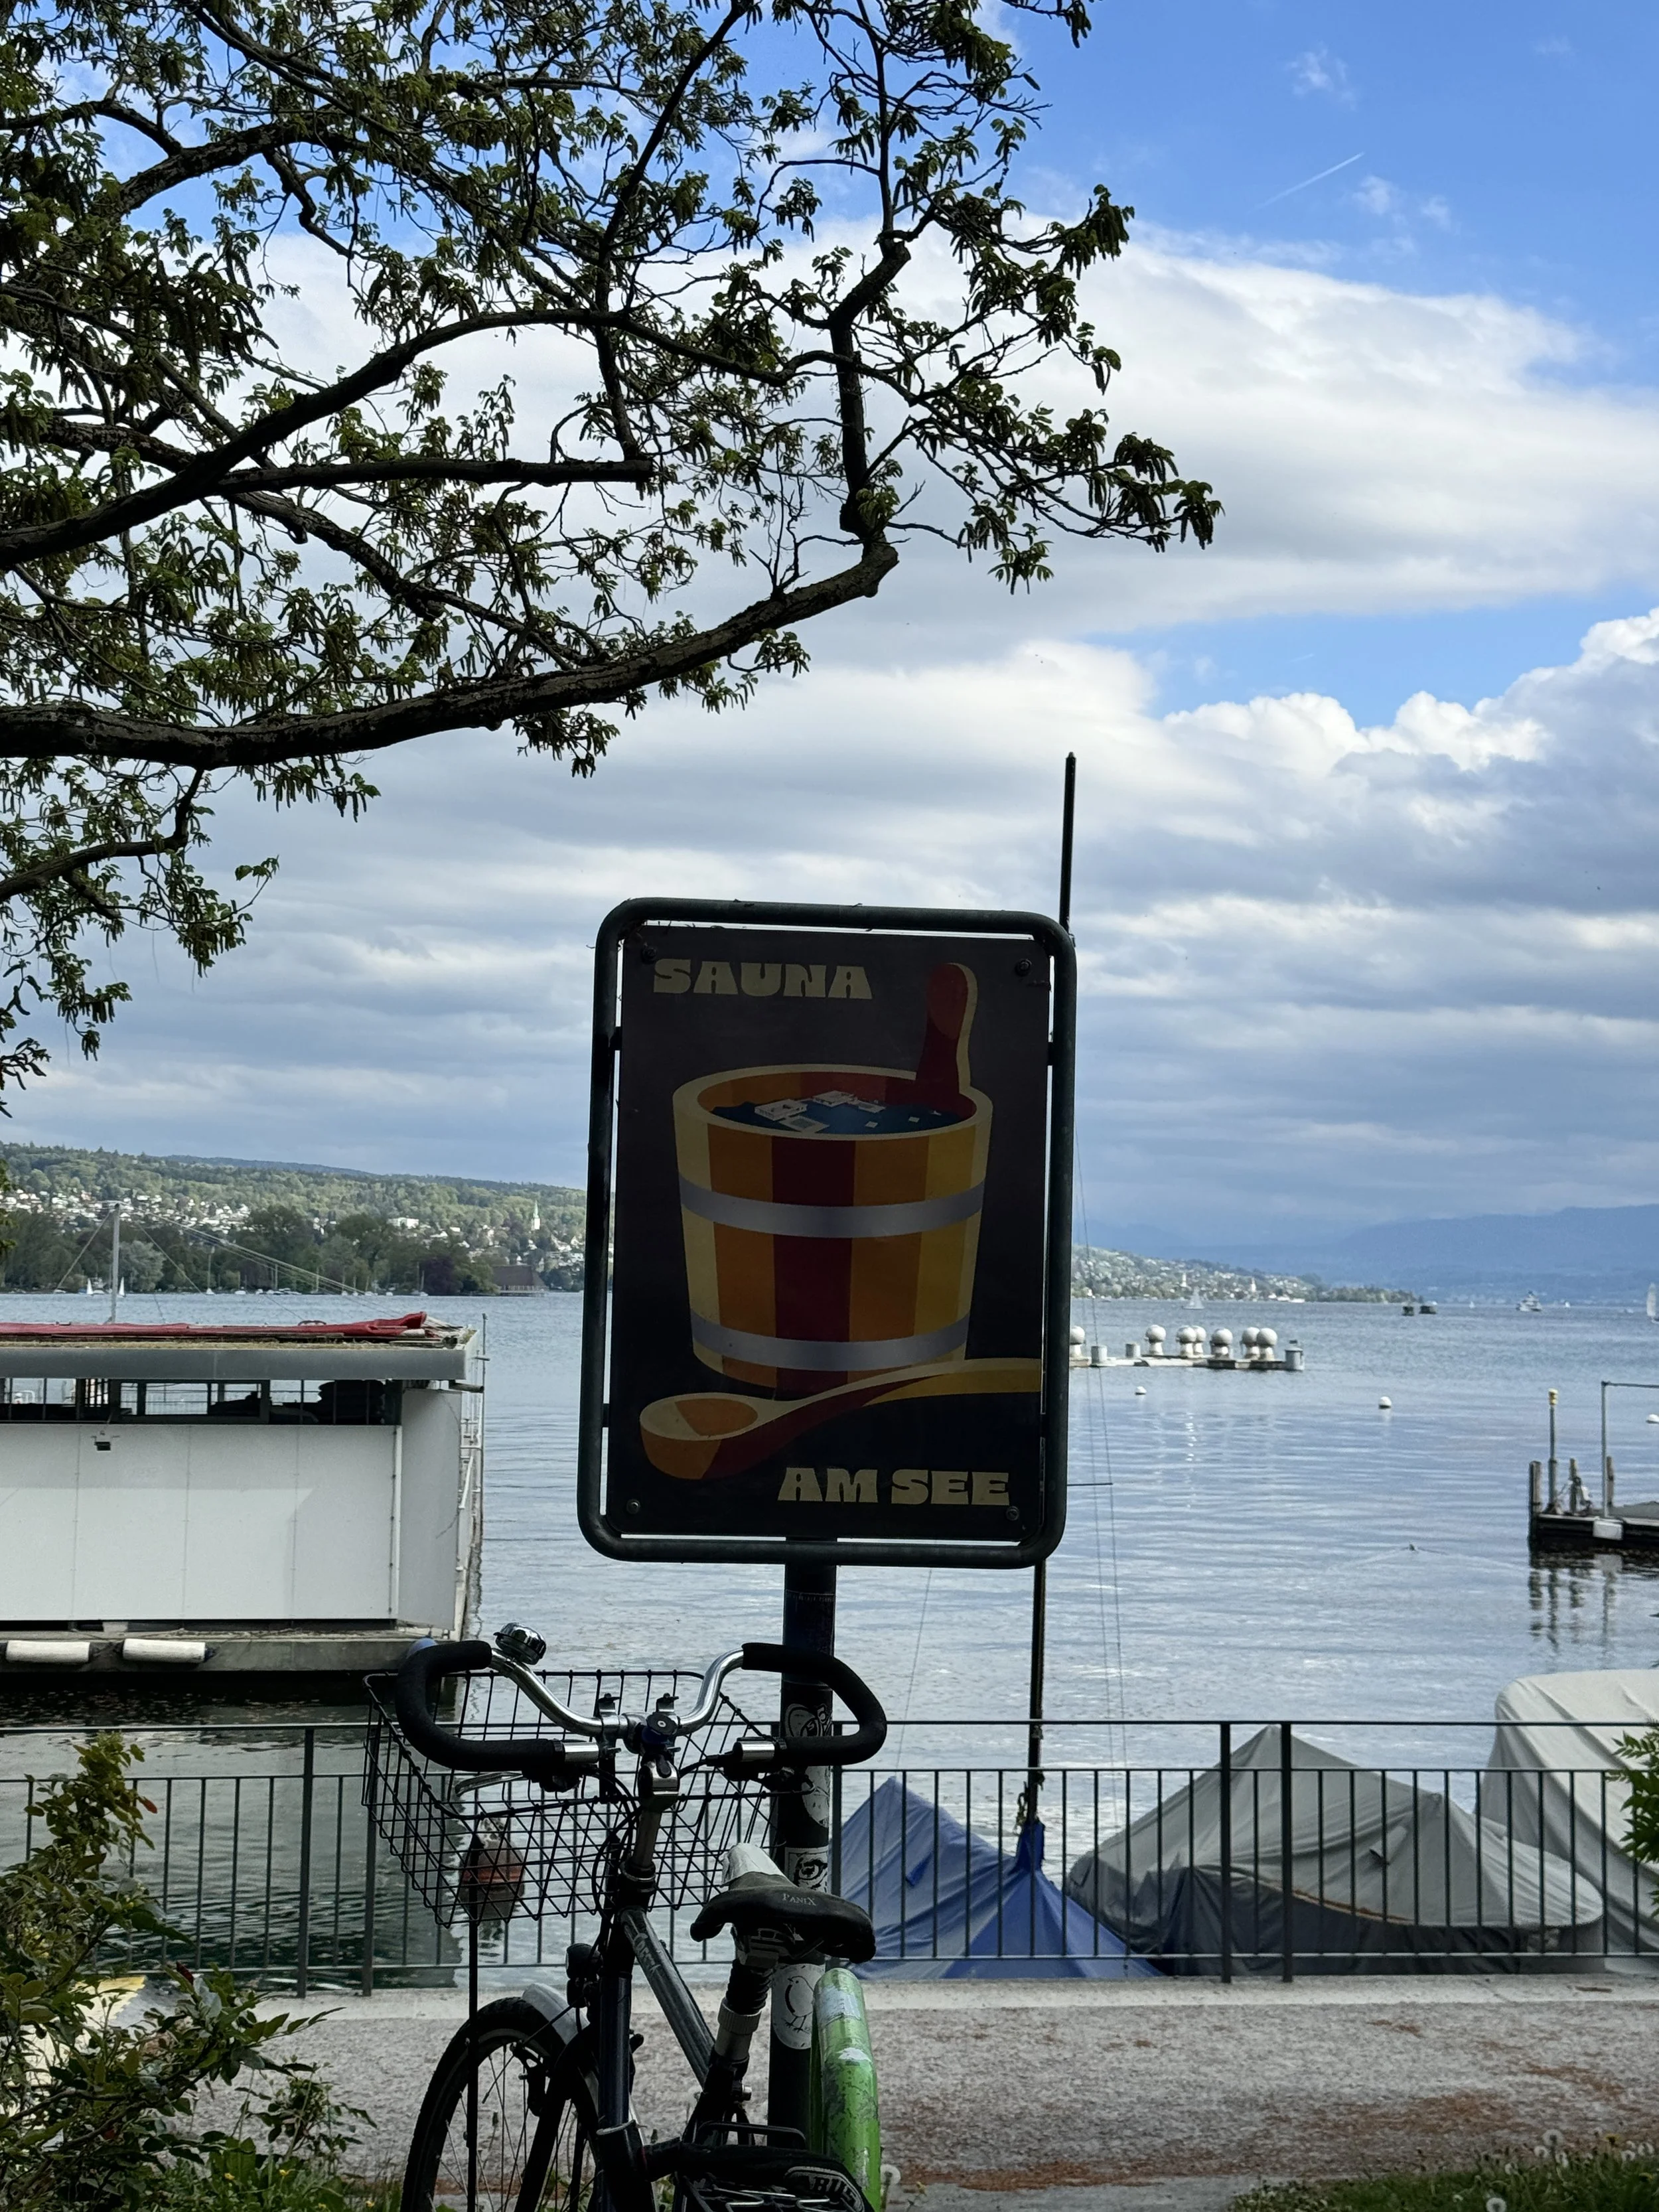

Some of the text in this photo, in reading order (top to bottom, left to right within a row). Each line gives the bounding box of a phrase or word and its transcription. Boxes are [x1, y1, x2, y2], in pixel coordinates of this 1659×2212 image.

[653, 958, 873, 999] SAUNA
[777, 1467, 1010, 1506] AM SEE
